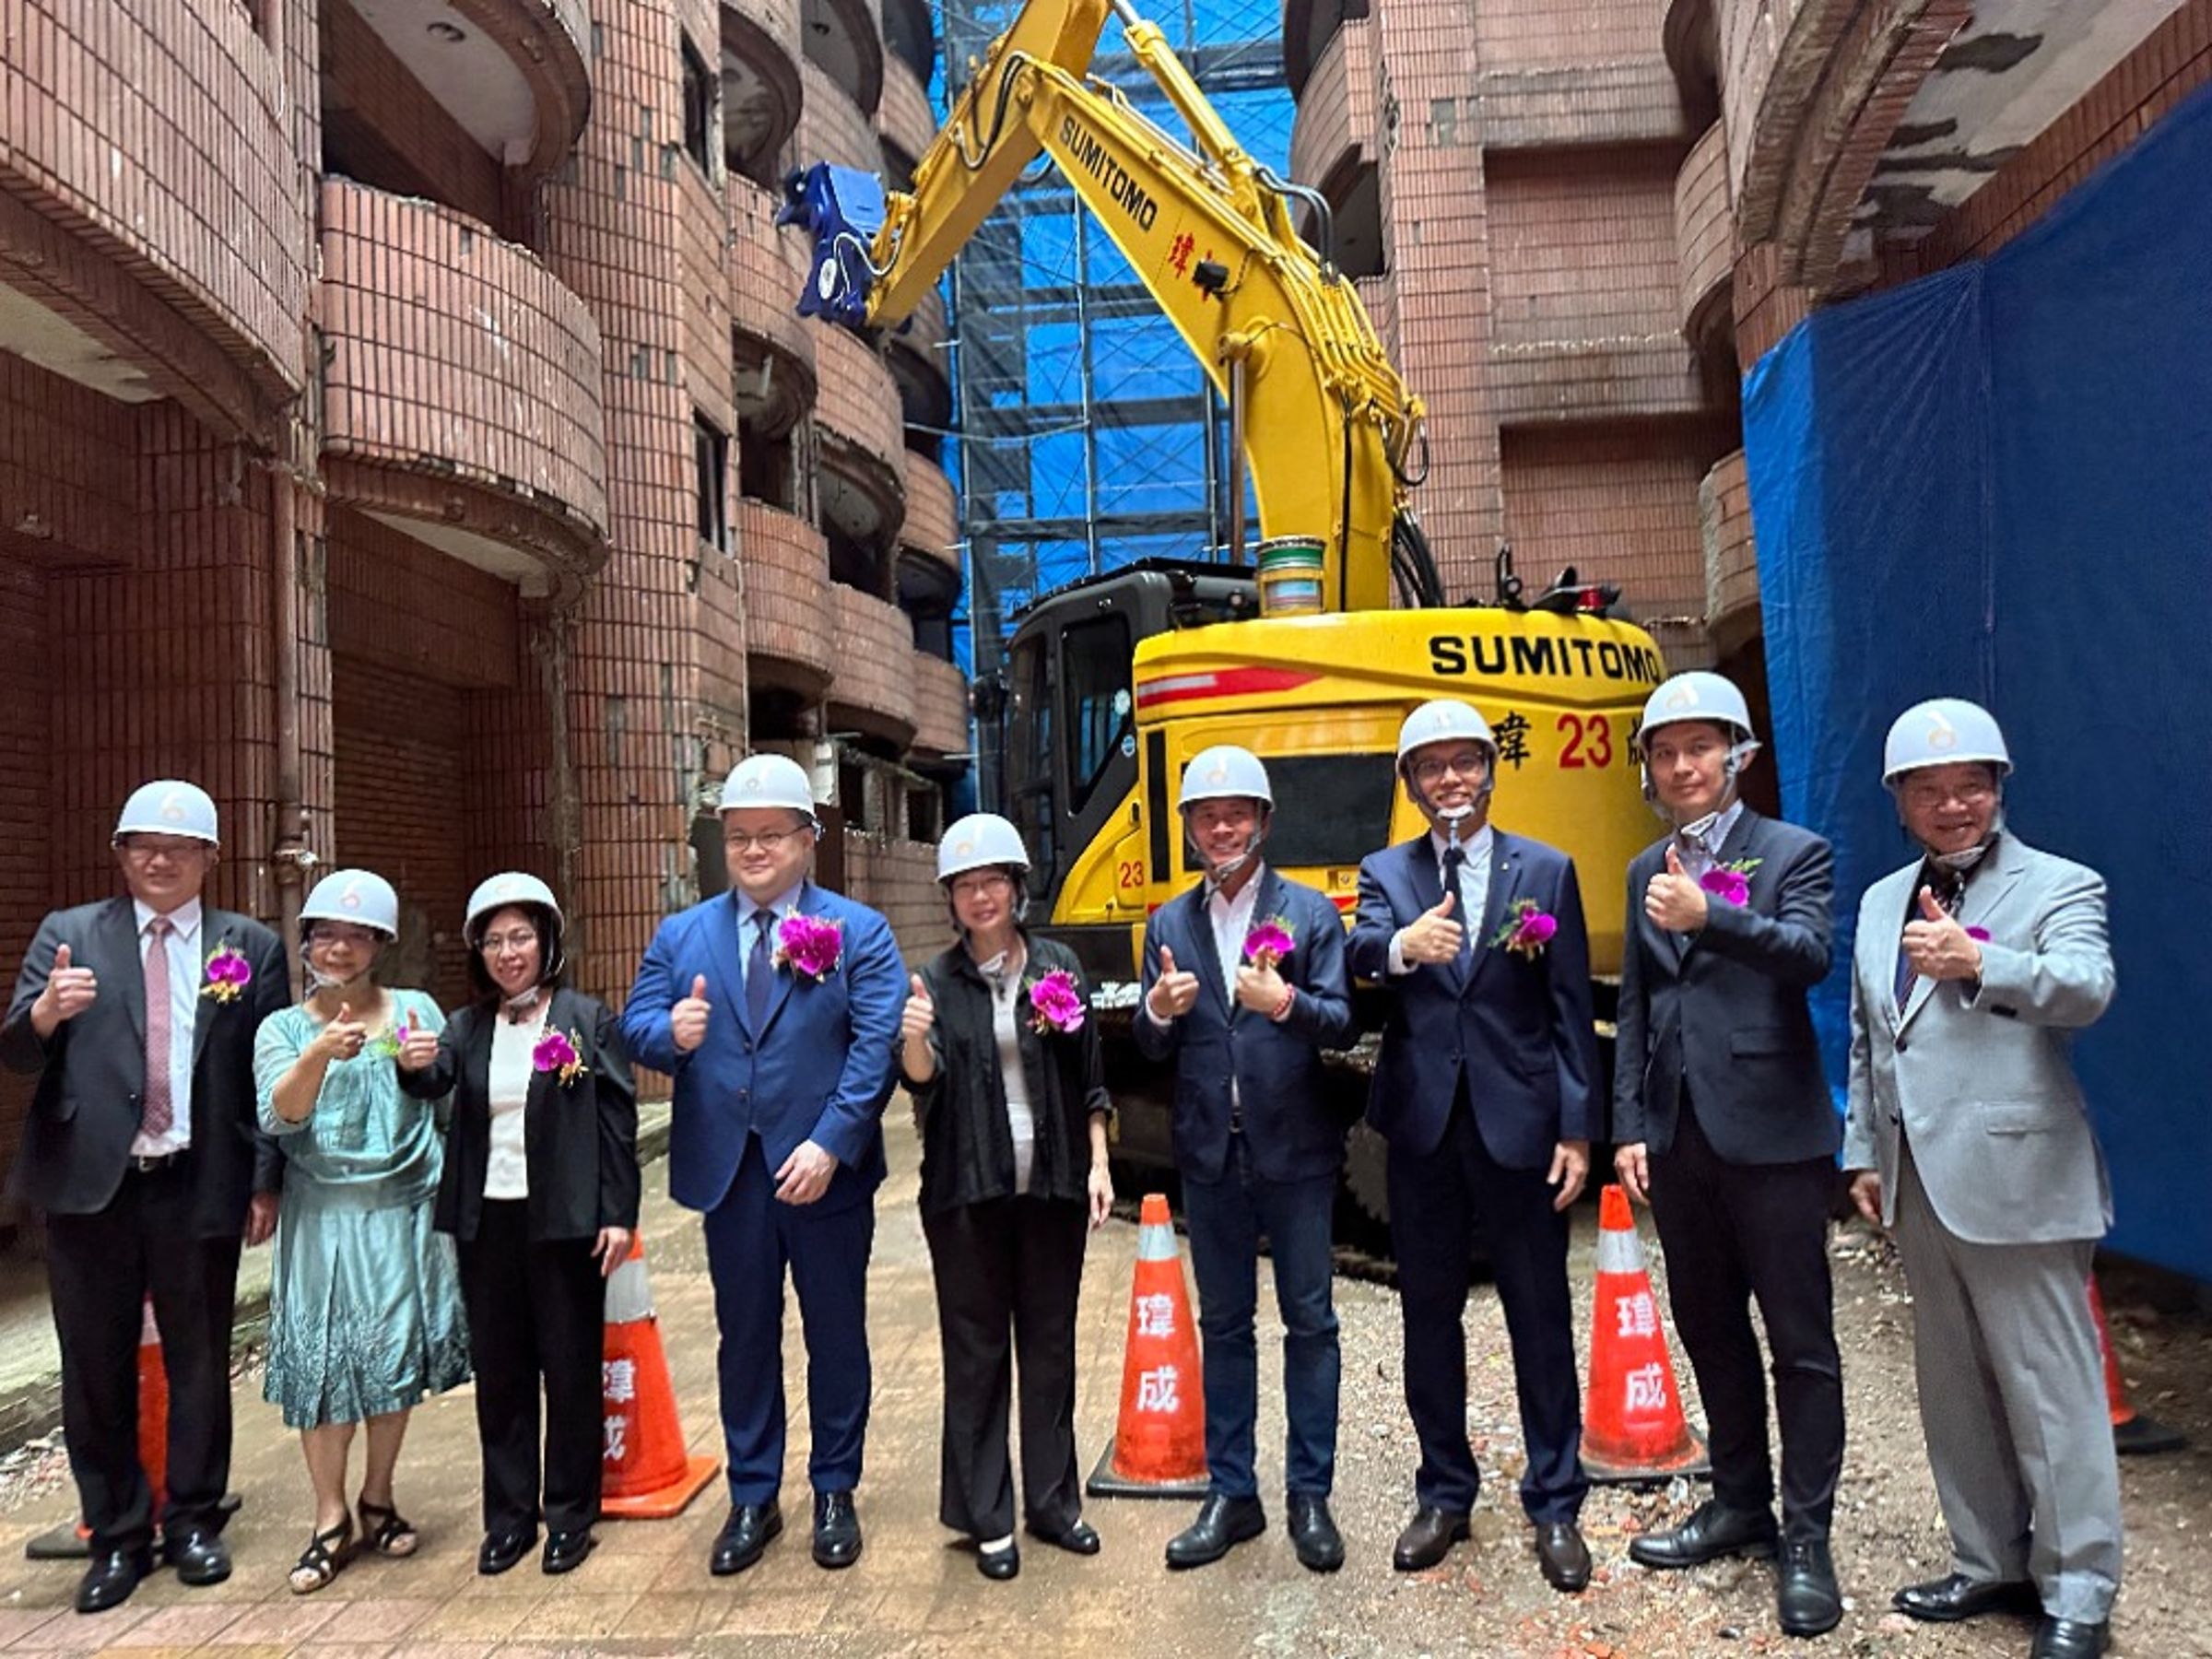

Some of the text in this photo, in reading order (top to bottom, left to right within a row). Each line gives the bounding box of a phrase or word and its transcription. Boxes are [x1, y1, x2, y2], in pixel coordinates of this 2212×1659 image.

[1058, 114, 1159, 232] SUMITOMO
[1429, 635, 1660, 685] SUMITOMO
[1557, 712, 1612, 770] 23
[1119, 860, 1145, 888] 23
